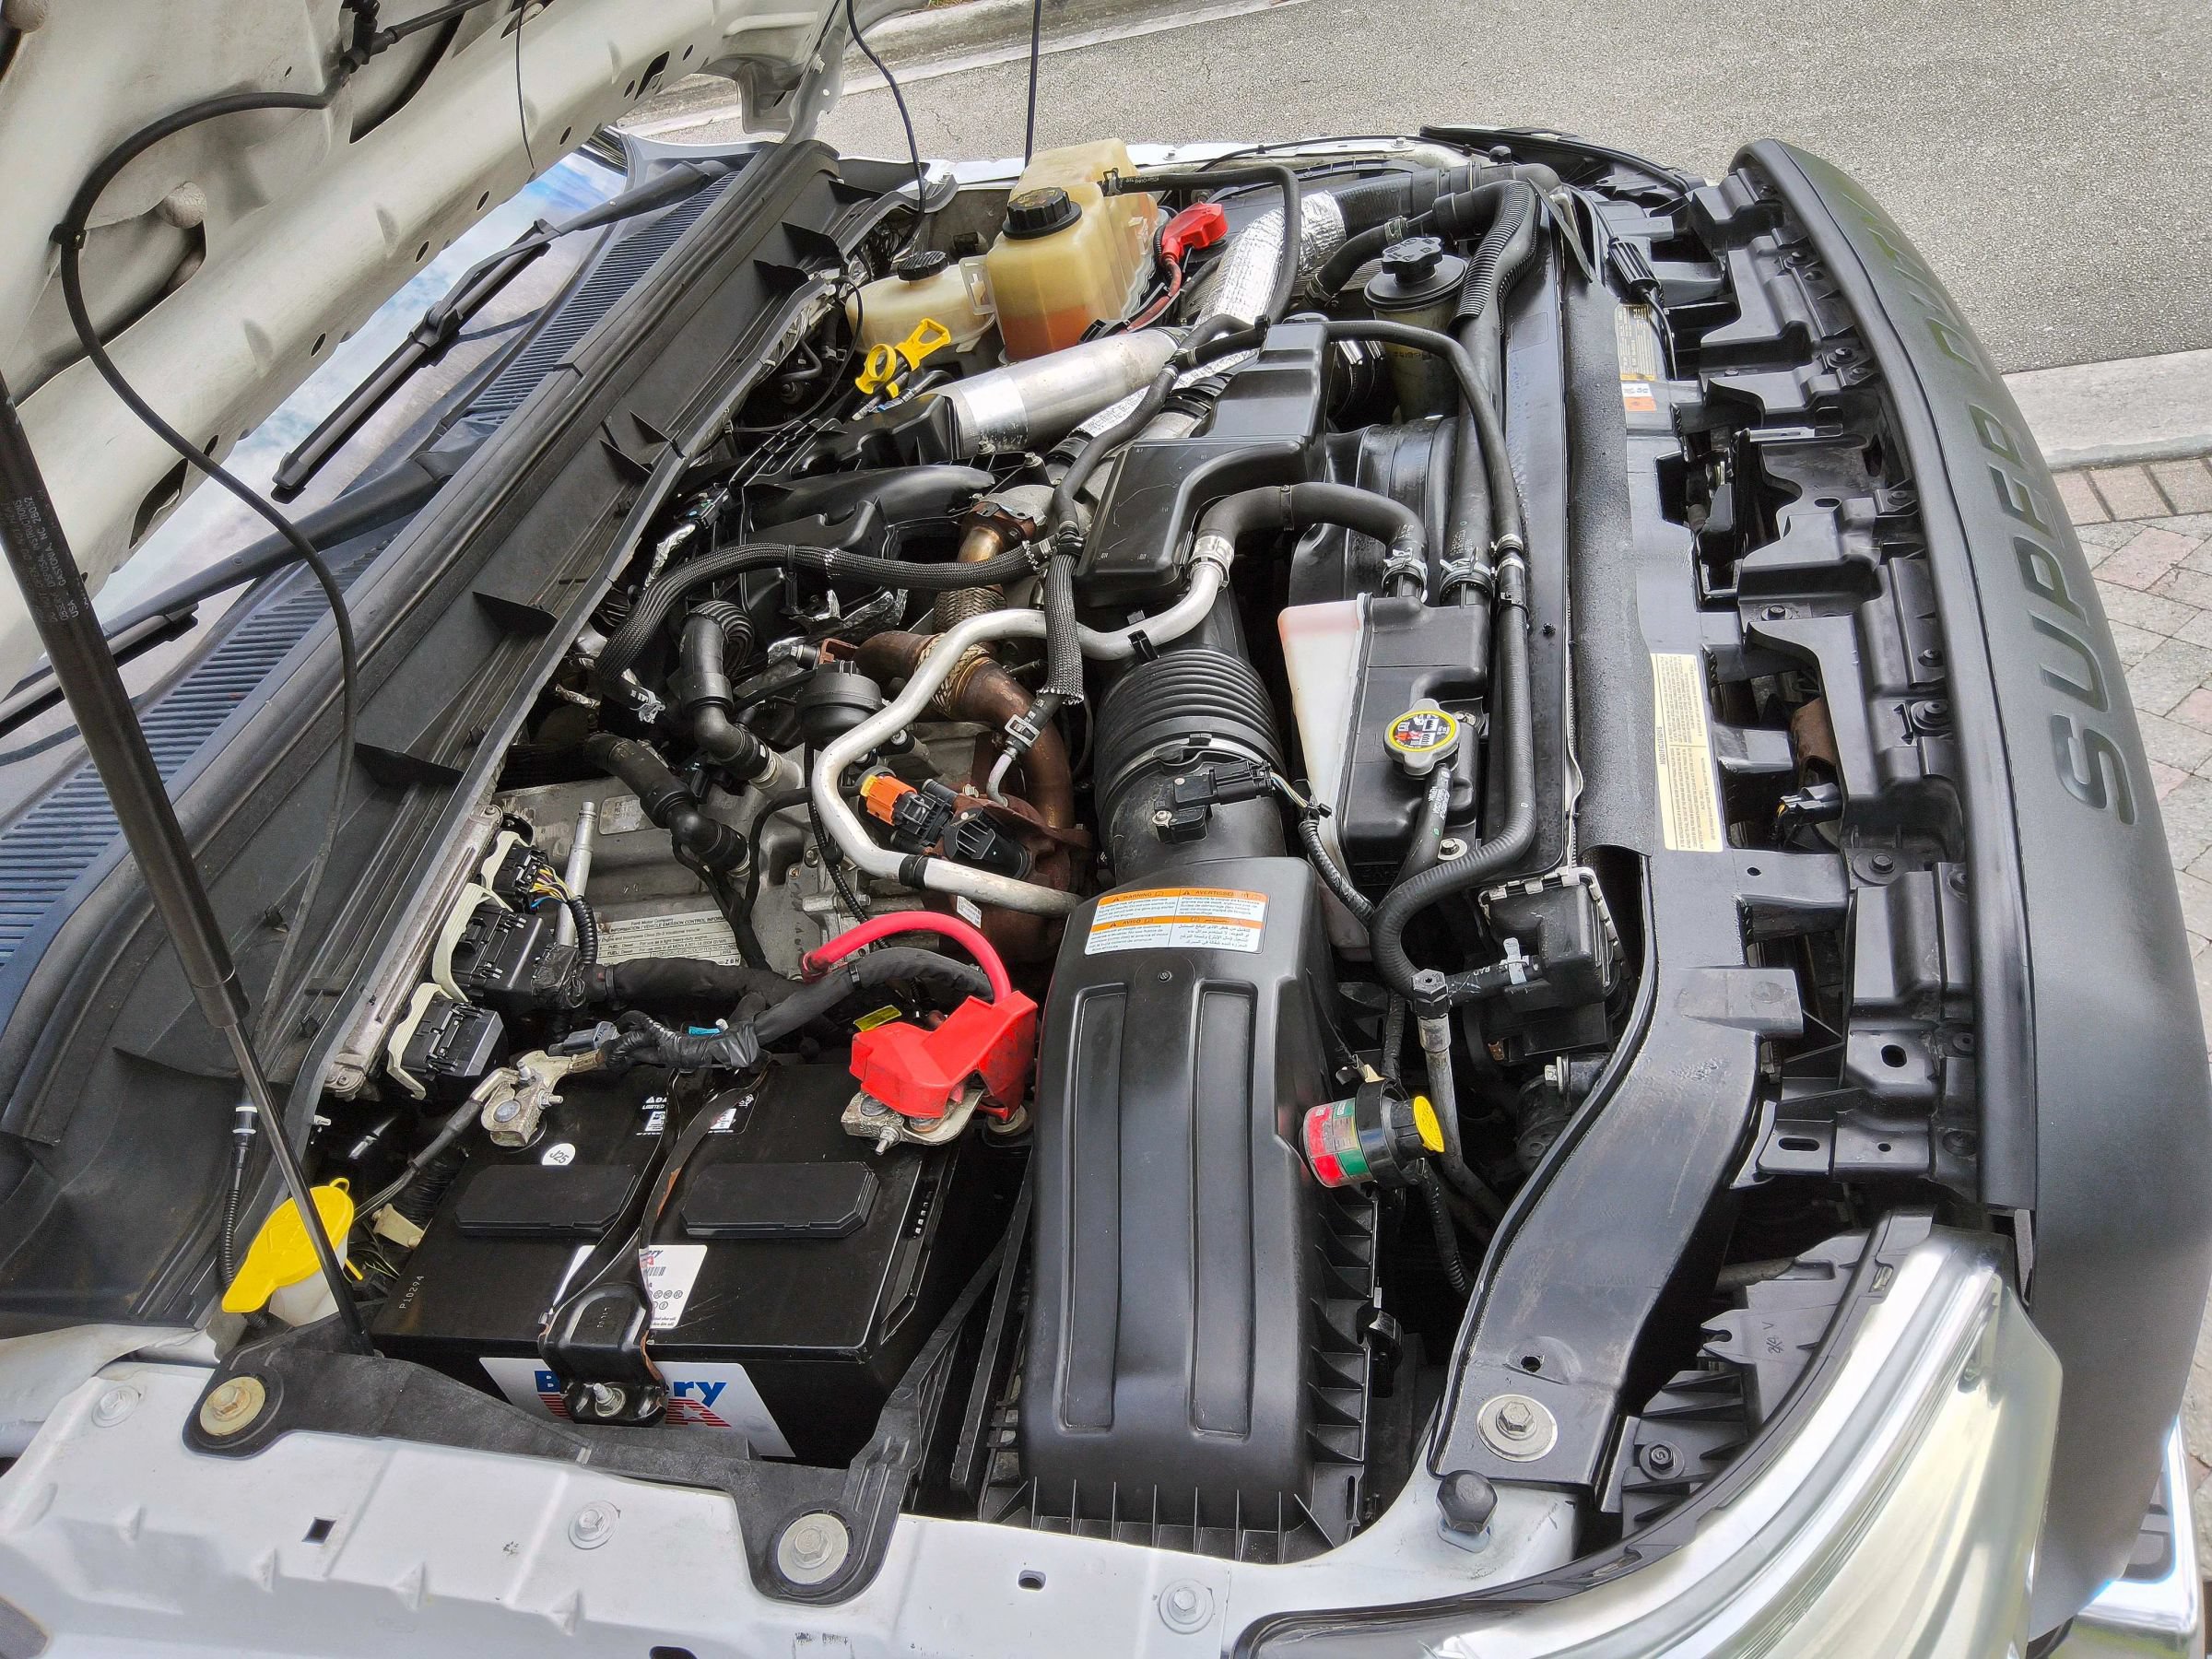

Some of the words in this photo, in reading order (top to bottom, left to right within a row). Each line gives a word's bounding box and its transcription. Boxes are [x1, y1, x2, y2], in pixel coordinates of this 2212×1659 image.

[38, 527, 48, 540] NC
[67, 599, 79, 618] USA
[1967, 403, 2137, 827] SUPER
[549, 1150, 570, 1164] J25
[398, 1276, 425, 1309] P10294
